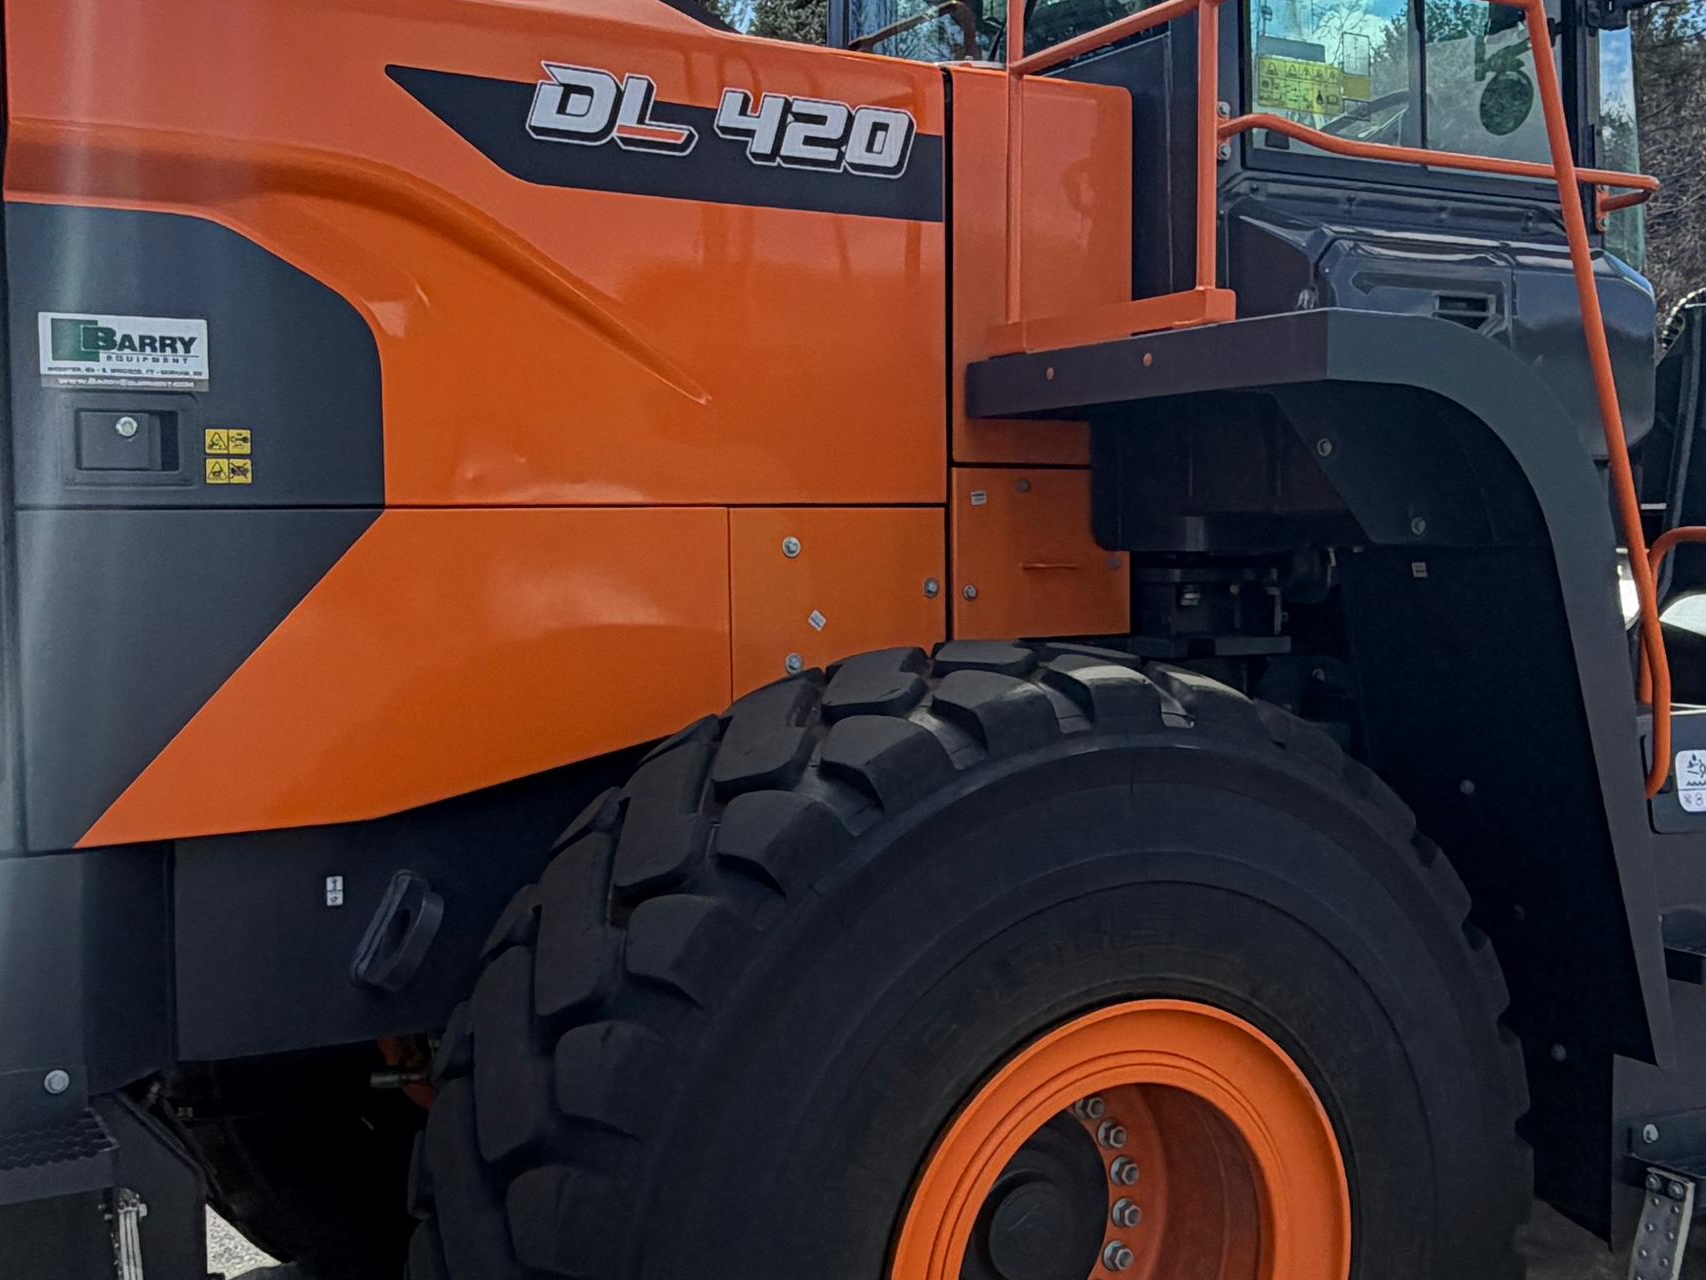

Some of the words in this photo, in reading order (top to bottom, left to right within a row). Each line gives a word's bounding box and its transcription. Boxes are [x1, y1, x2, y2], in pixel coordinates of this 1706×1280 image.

[526, 61, 697, 156] DL
[714, 87, 916, 179] 420
[82, 326, 197, 354] BARRY
